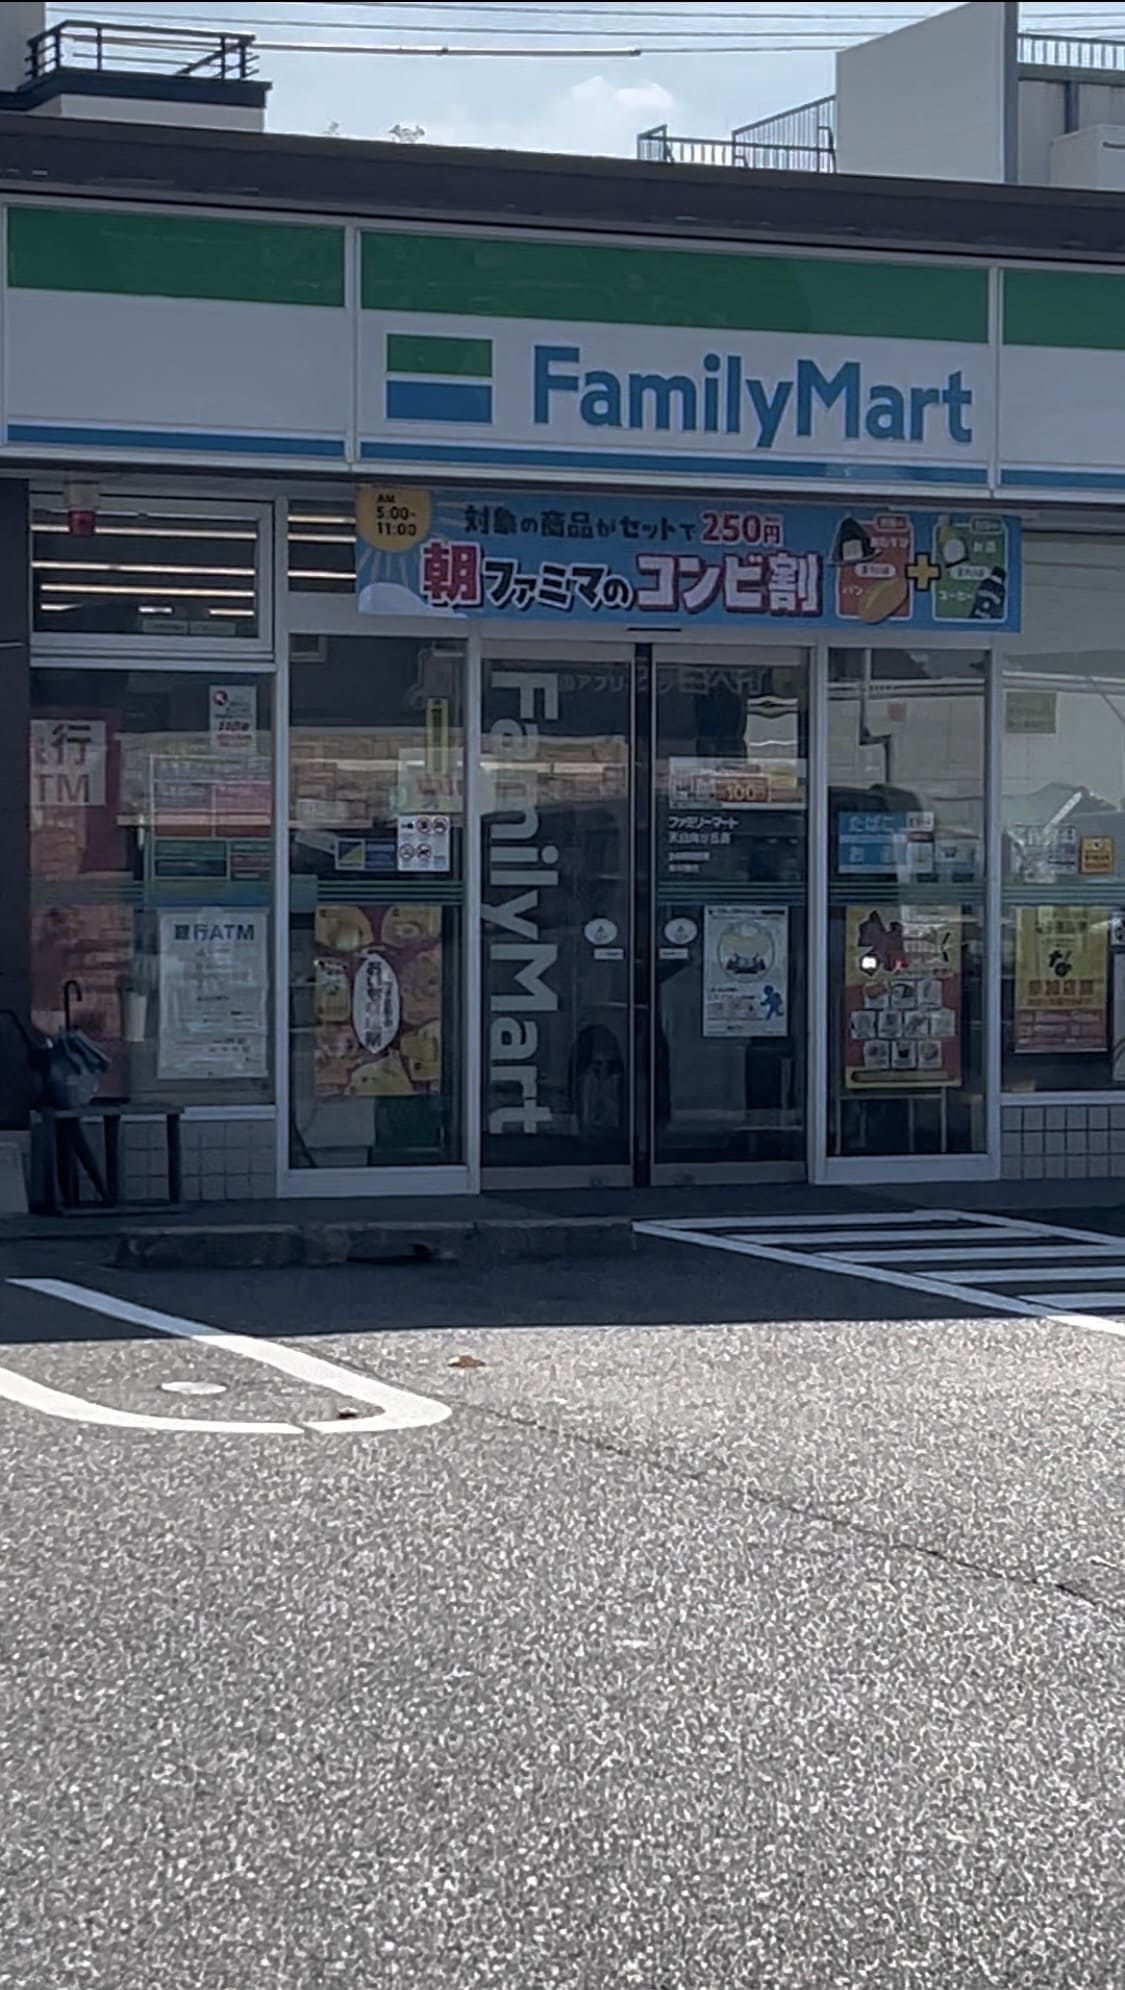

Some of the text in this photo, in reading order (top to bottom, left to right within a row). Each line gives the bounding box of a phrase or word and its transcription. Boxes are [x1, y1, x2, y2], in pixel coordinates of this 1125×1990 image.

[532, 345, 973, 449] FamilyMart
[377, 494, 396, 504] AM
[377, 521, 417, 537] 11:00
[421, 537, 823, 616] 朝ファミマのコンビ割
[668, 815, 739, 829] ファミリーマート
[479, 671, 559, 1135] FamilyMart
